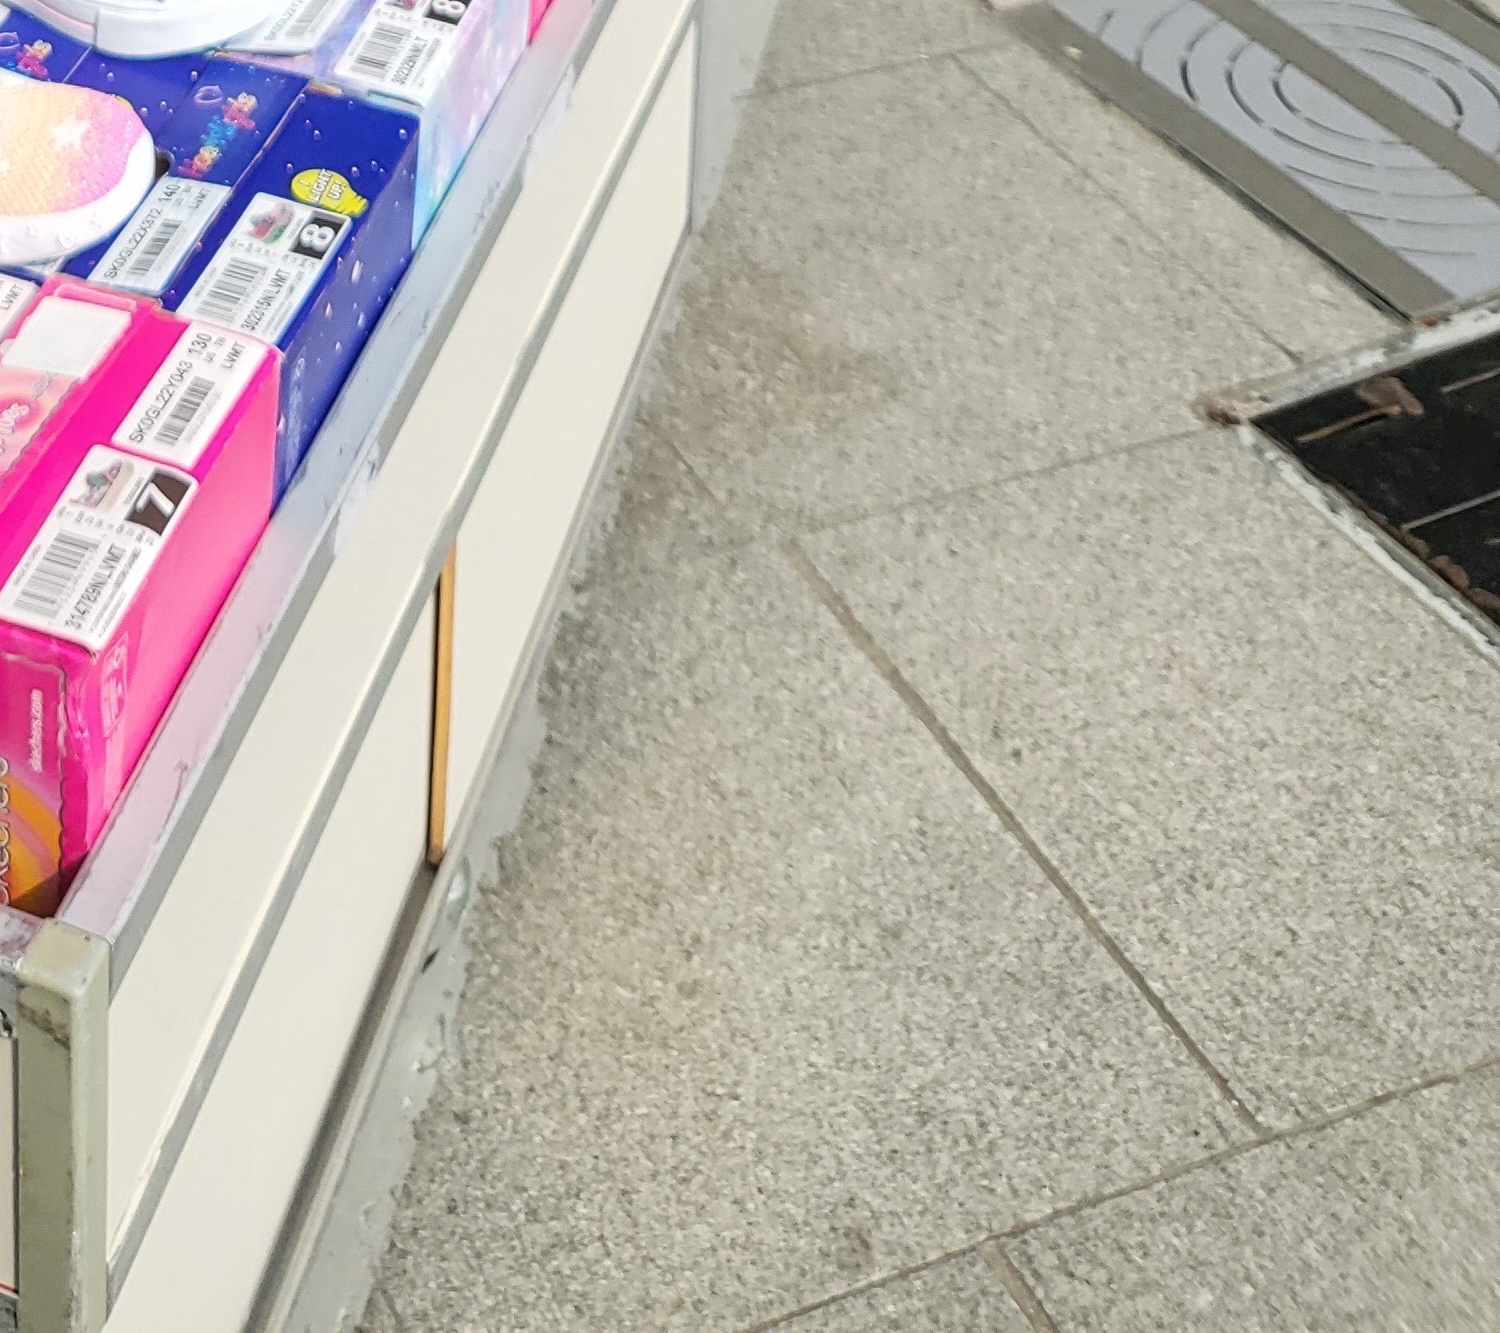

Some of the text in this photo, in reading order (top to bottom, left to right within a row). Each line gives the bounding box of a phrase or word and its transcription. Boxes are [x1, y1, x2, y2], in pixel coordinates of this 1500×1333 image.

[308, 168, 333, 203] LIGHT
[301, 222, 337, 253] 8
[188, 331, 213, 356] 130
[135, 482, 176, 519] 7
